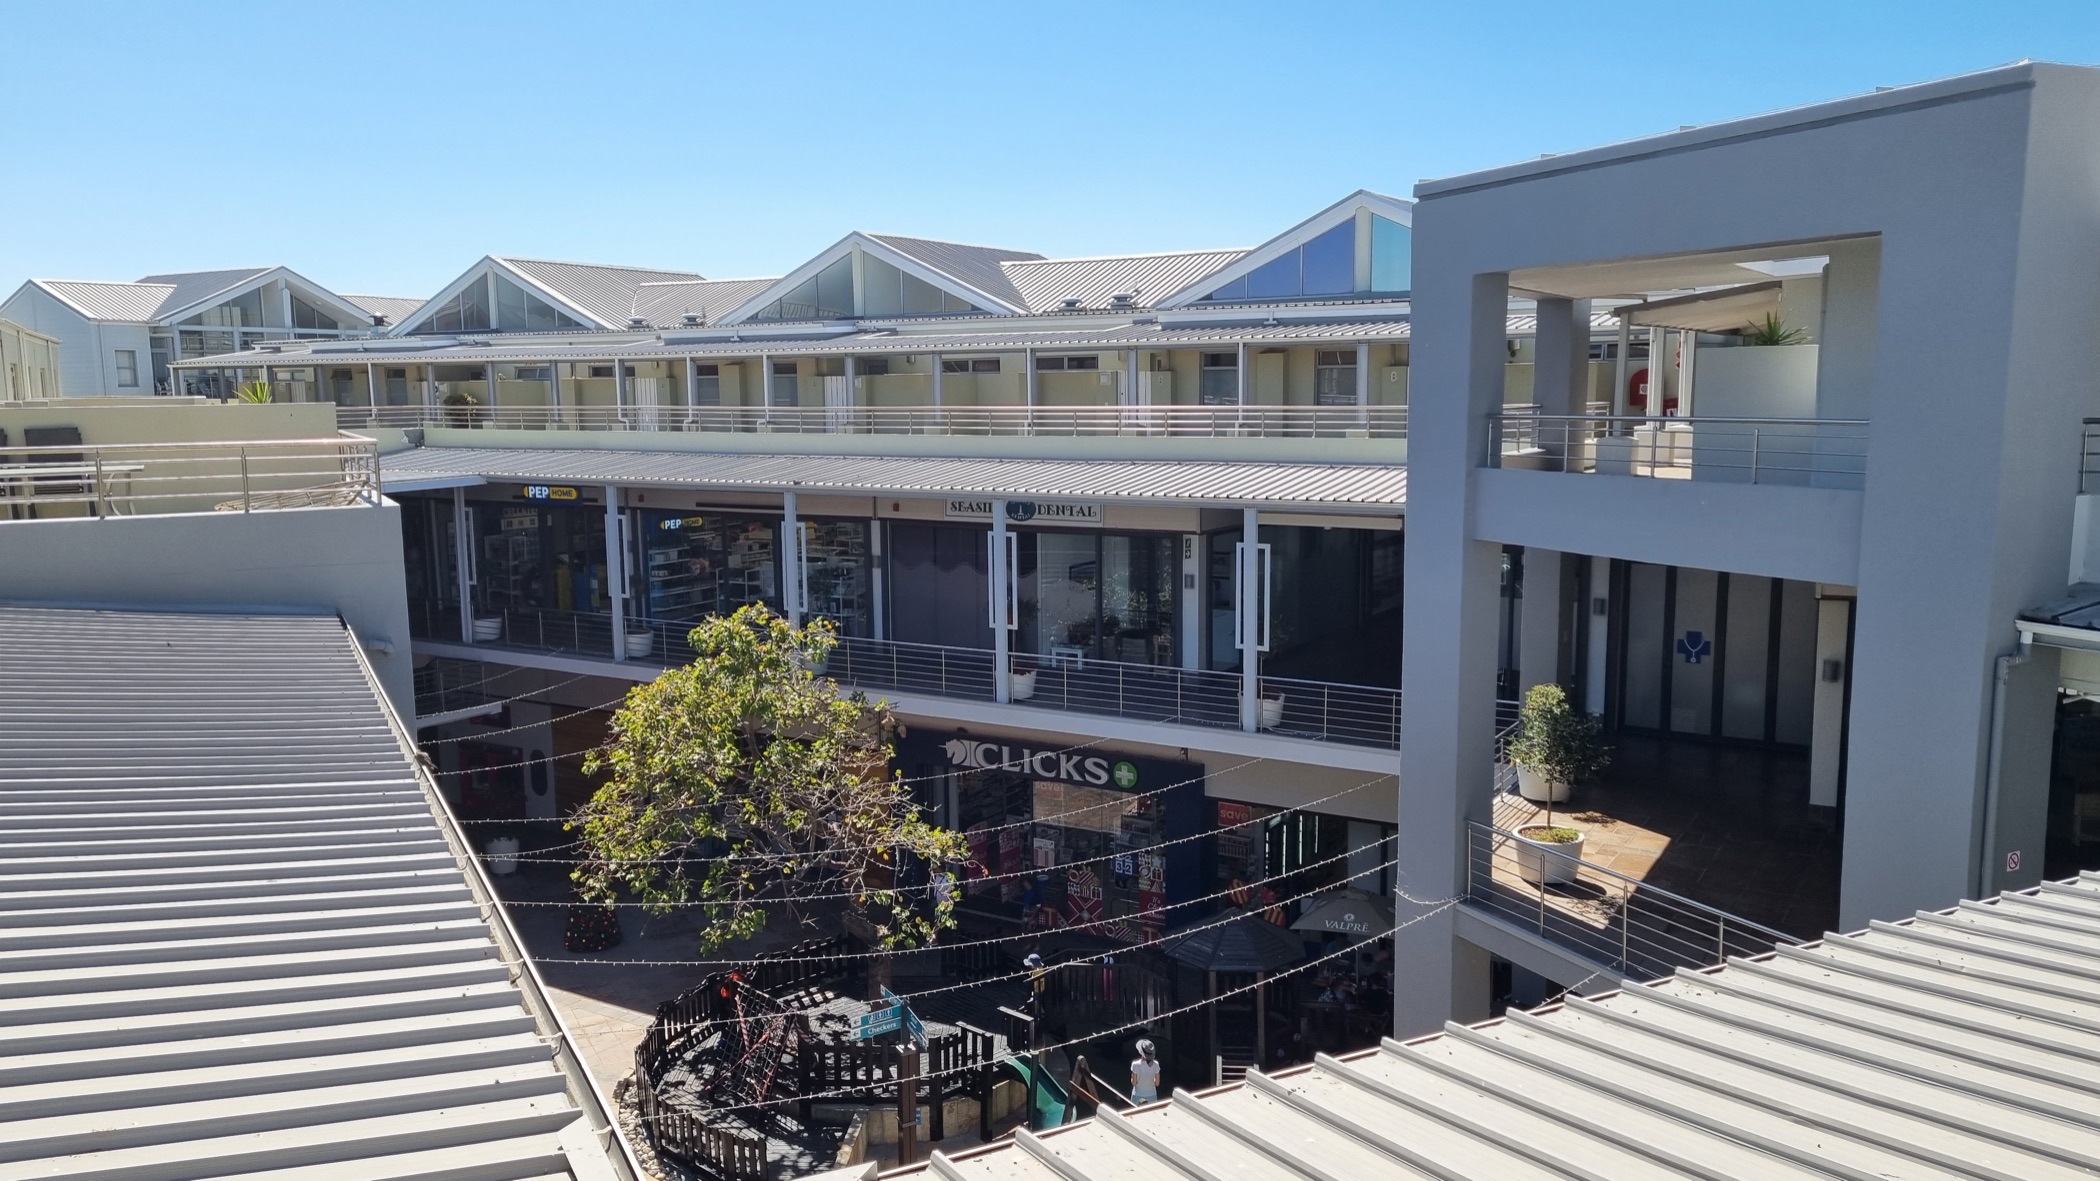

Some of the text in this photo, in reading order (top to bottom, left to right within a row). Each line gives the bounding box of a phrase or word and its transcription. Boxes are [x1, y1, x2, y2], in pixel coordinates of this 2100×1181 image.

[528, 486, 573, 499] PEP HOME
[950, 500, 993, 514] SEASI
[1037, 504, 1097, 517] DENTAL
[664, 518, 682, 530] PEP
[975, 742, 1110, 785] CLICKS
[1220, 809, 1249, 821] save
[867, 1022, 897, 1035] Checkers
